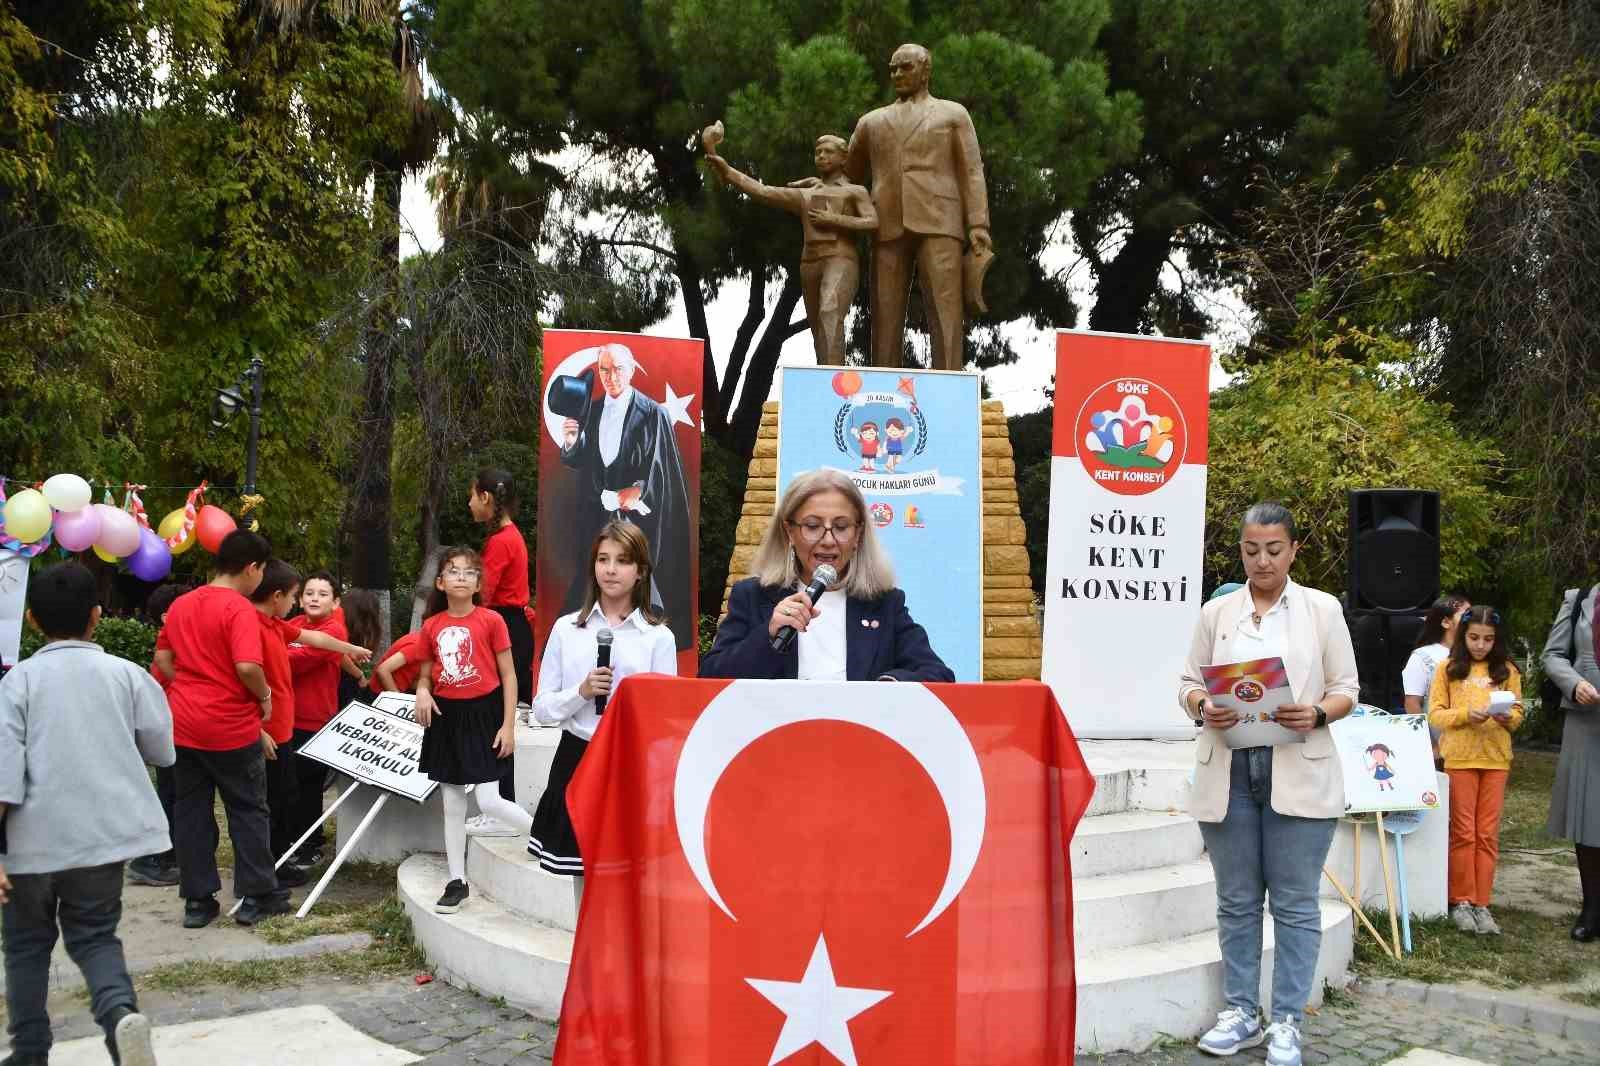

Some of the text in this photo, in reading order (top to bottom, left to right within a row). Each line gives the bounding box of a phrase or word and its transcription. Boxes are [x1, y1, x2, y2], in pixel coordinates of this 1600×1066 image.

[1116, 381, 1149, 394] SÖKE
[852, 478, 878, 490] OCUK
[879, 479, 911, 490] HAKLARI
[1094, 469, 1165, 483] KENT KONSEYİ
[1090, 510, 1166, 537] SÖKE
[1088, 545, 1165, 569] KENT
[1061, 576, 1188, 602] KONSEYİ
[330, 722, 420, 762] NEBAHAT AL
[337, 739, 415, 776] İLKOKULU
